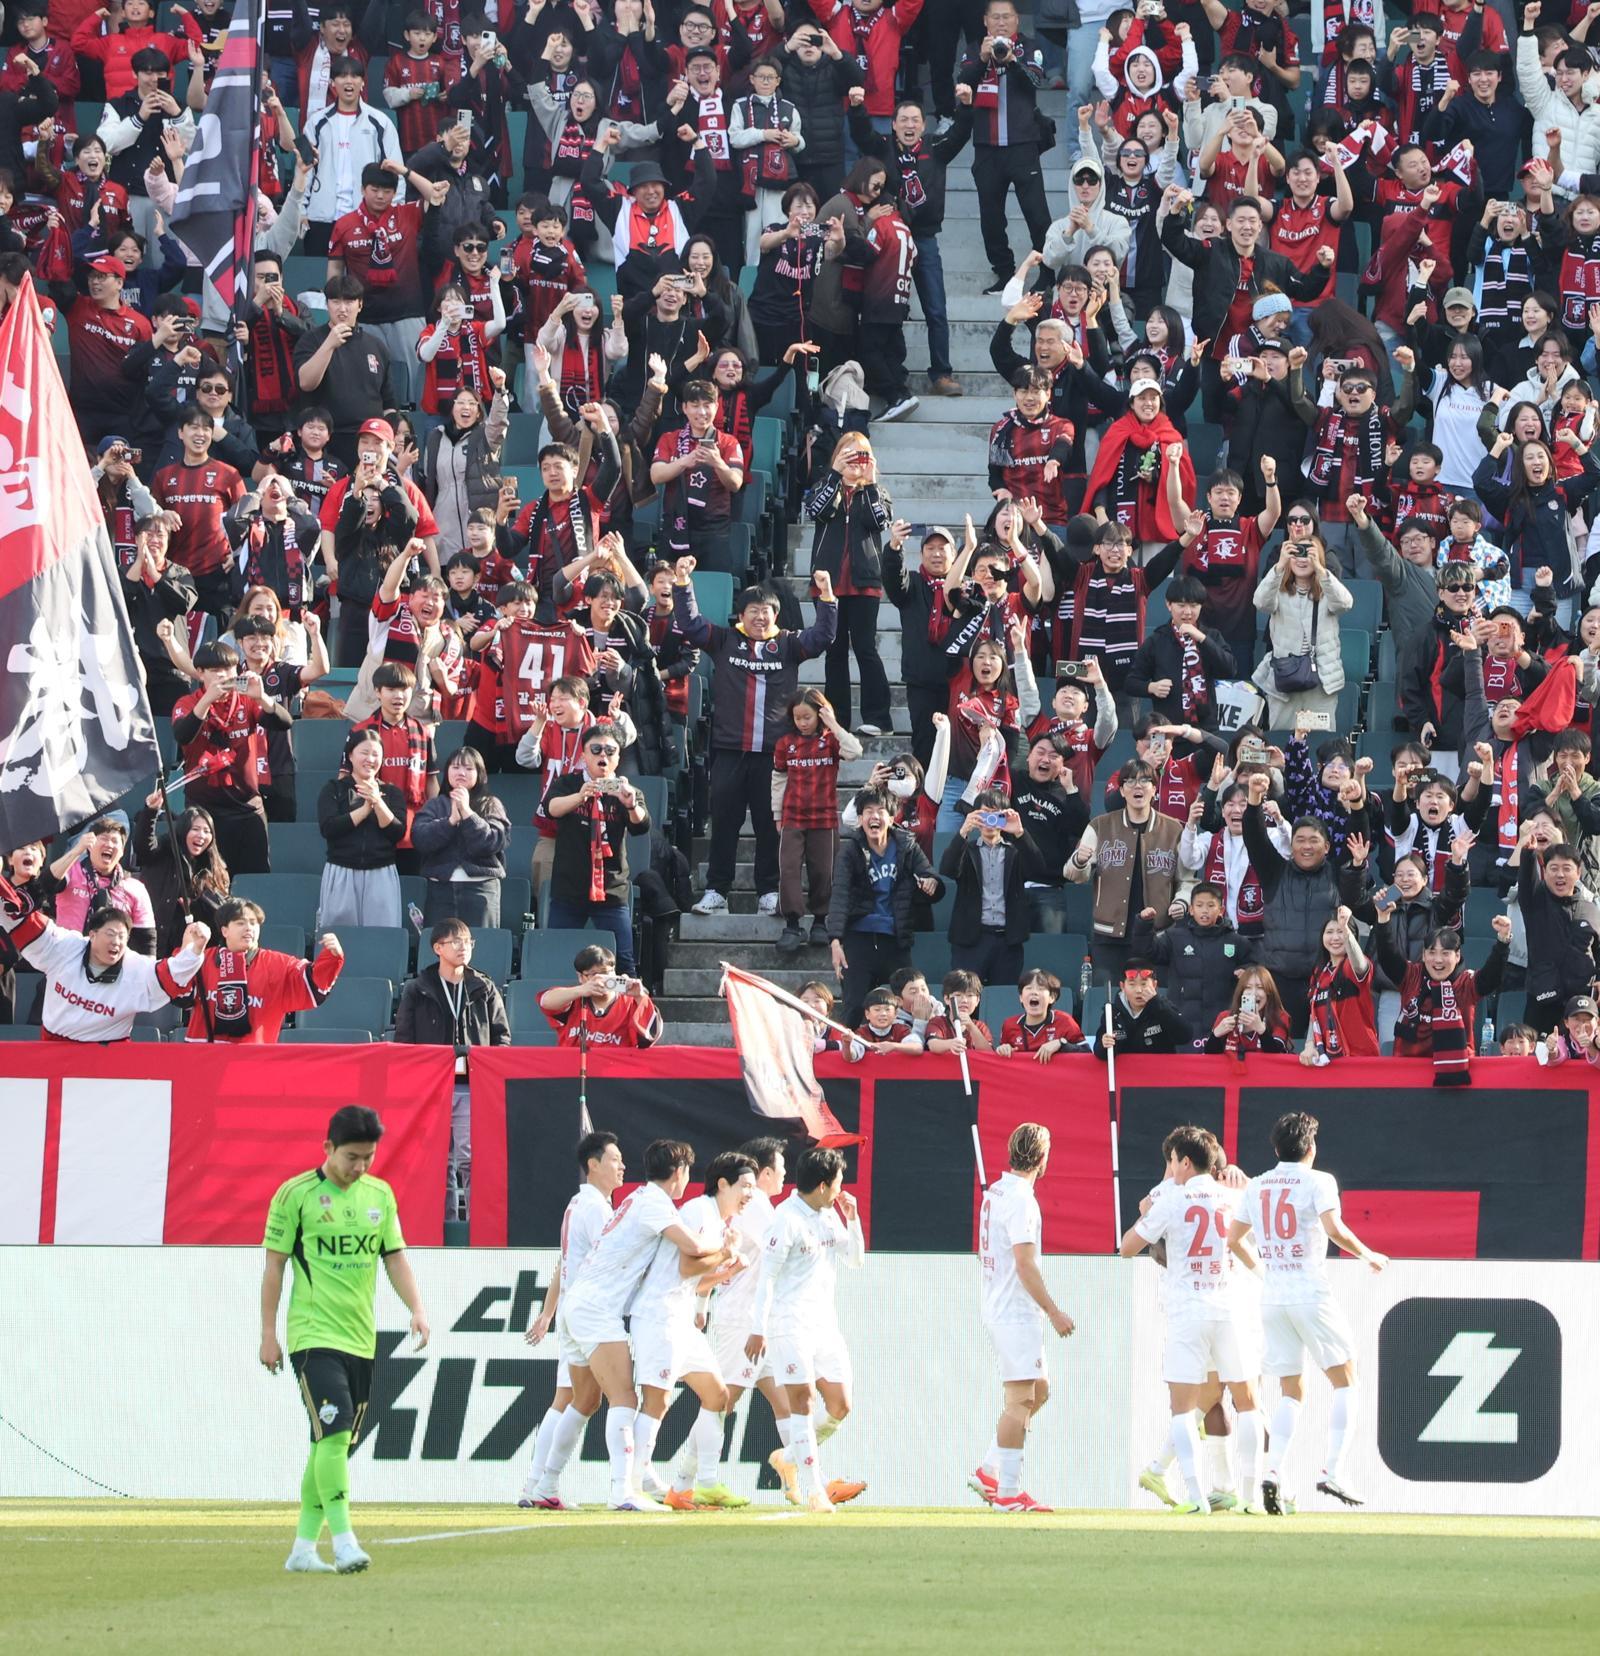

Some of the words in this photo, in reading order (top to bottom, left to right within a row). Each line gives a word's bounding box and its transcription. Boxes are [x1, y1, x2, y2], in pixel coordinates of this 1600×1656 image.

[1370, 431, 1382, 472] HOME
[518, 642, 565, 690] 41
[728, 656, 783, 670] 부천자생한방병원
[54, 981, 116, 1018] BUCHEON
[1441, 980, 1458, 1022] EDS
[1536, 990, 1557, 1001] adidas
[1259, 1188, 1298, 1241] 16
